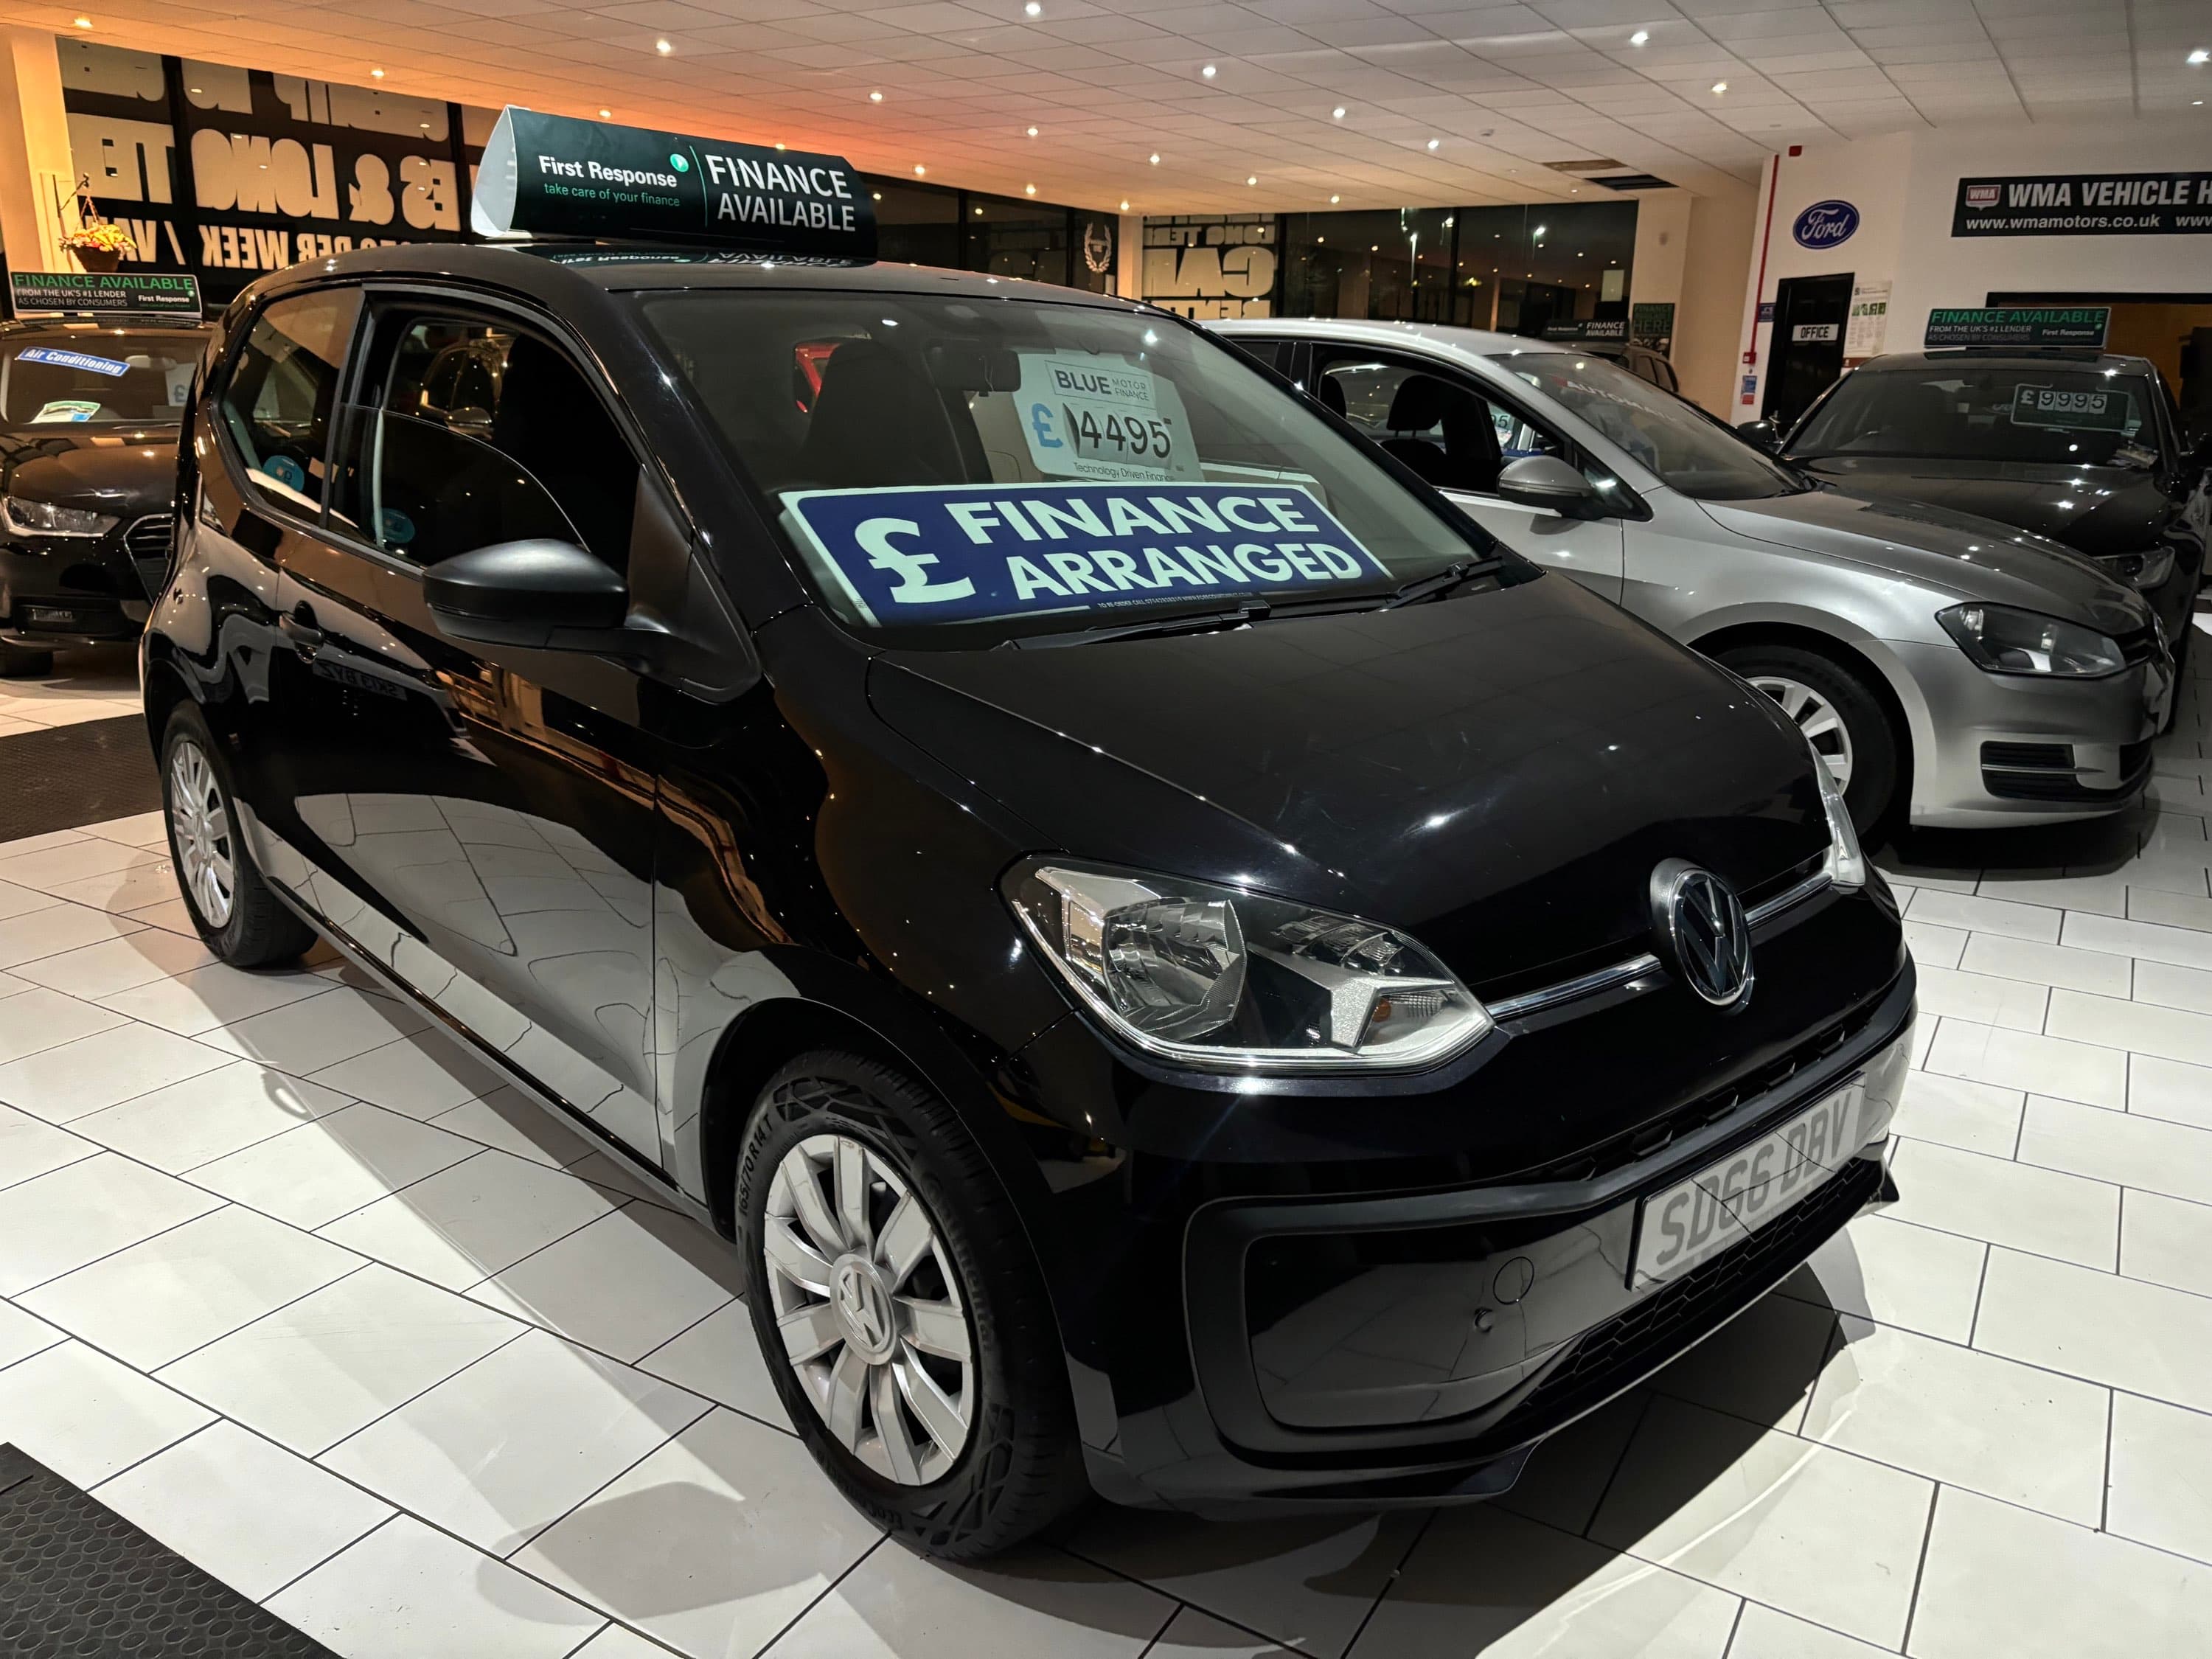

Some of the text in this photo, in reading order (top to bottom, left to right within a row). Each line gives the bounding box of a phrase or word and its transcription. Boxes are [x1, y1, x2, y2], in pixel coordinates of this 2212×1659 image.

[537, 154, 678, 189] First Response
[705, 153, 853, 200] FINANCE
[543, 181, 681, 207] take care of your finance
[1969, 189, 1997, 200] WMA
[2008, 183, 2072, 207] WMA
[2081, 180, 2191, 206] VEHICLE
[717, 192, 856, 232] AVAILABLE
[1966, 213, 2160, 229] www.wmamotors.co.uk
[1800, 208, 1850, 240] Ford
[14, 274, 195, 291] FINANCE AVAILABLE
[15, 288, 41, 297] FROM
[42, 289, 60, 297] THE
[61, 289, 81, 298] UK'S
[30, 298, 65, 306] CHOSEN
[78, 299, 128, 307] CONSUMERS
[156, 295, 190, 304] Response
[1586, 321, 1626, 330] FINANCE
[1931, 310, 2107, 323] FINANCE AVAILABLE
[1800, 326, 1829, 338] OFFICE
[25, 348, 123, 374] Air Conditioning
[1054, 369, 1112, 395] BLUE
[1112, 378, 1147, 390] MOTOR
[1115, 387, 1150, 401] FINANCE
[2020, 390, 2105, 409] £ 9995
[1032, 403, 1171, 458] £ 4495
[1073, 462, 1120, 478] Technology
[1120, 467, 1146, 479] Driven
[854, 495, 1320, 604] £ FINANCE
[1006, 543, 1363, 601] ARRANGED
[1656, 1091, 1853, 1266] SD66 DBV
